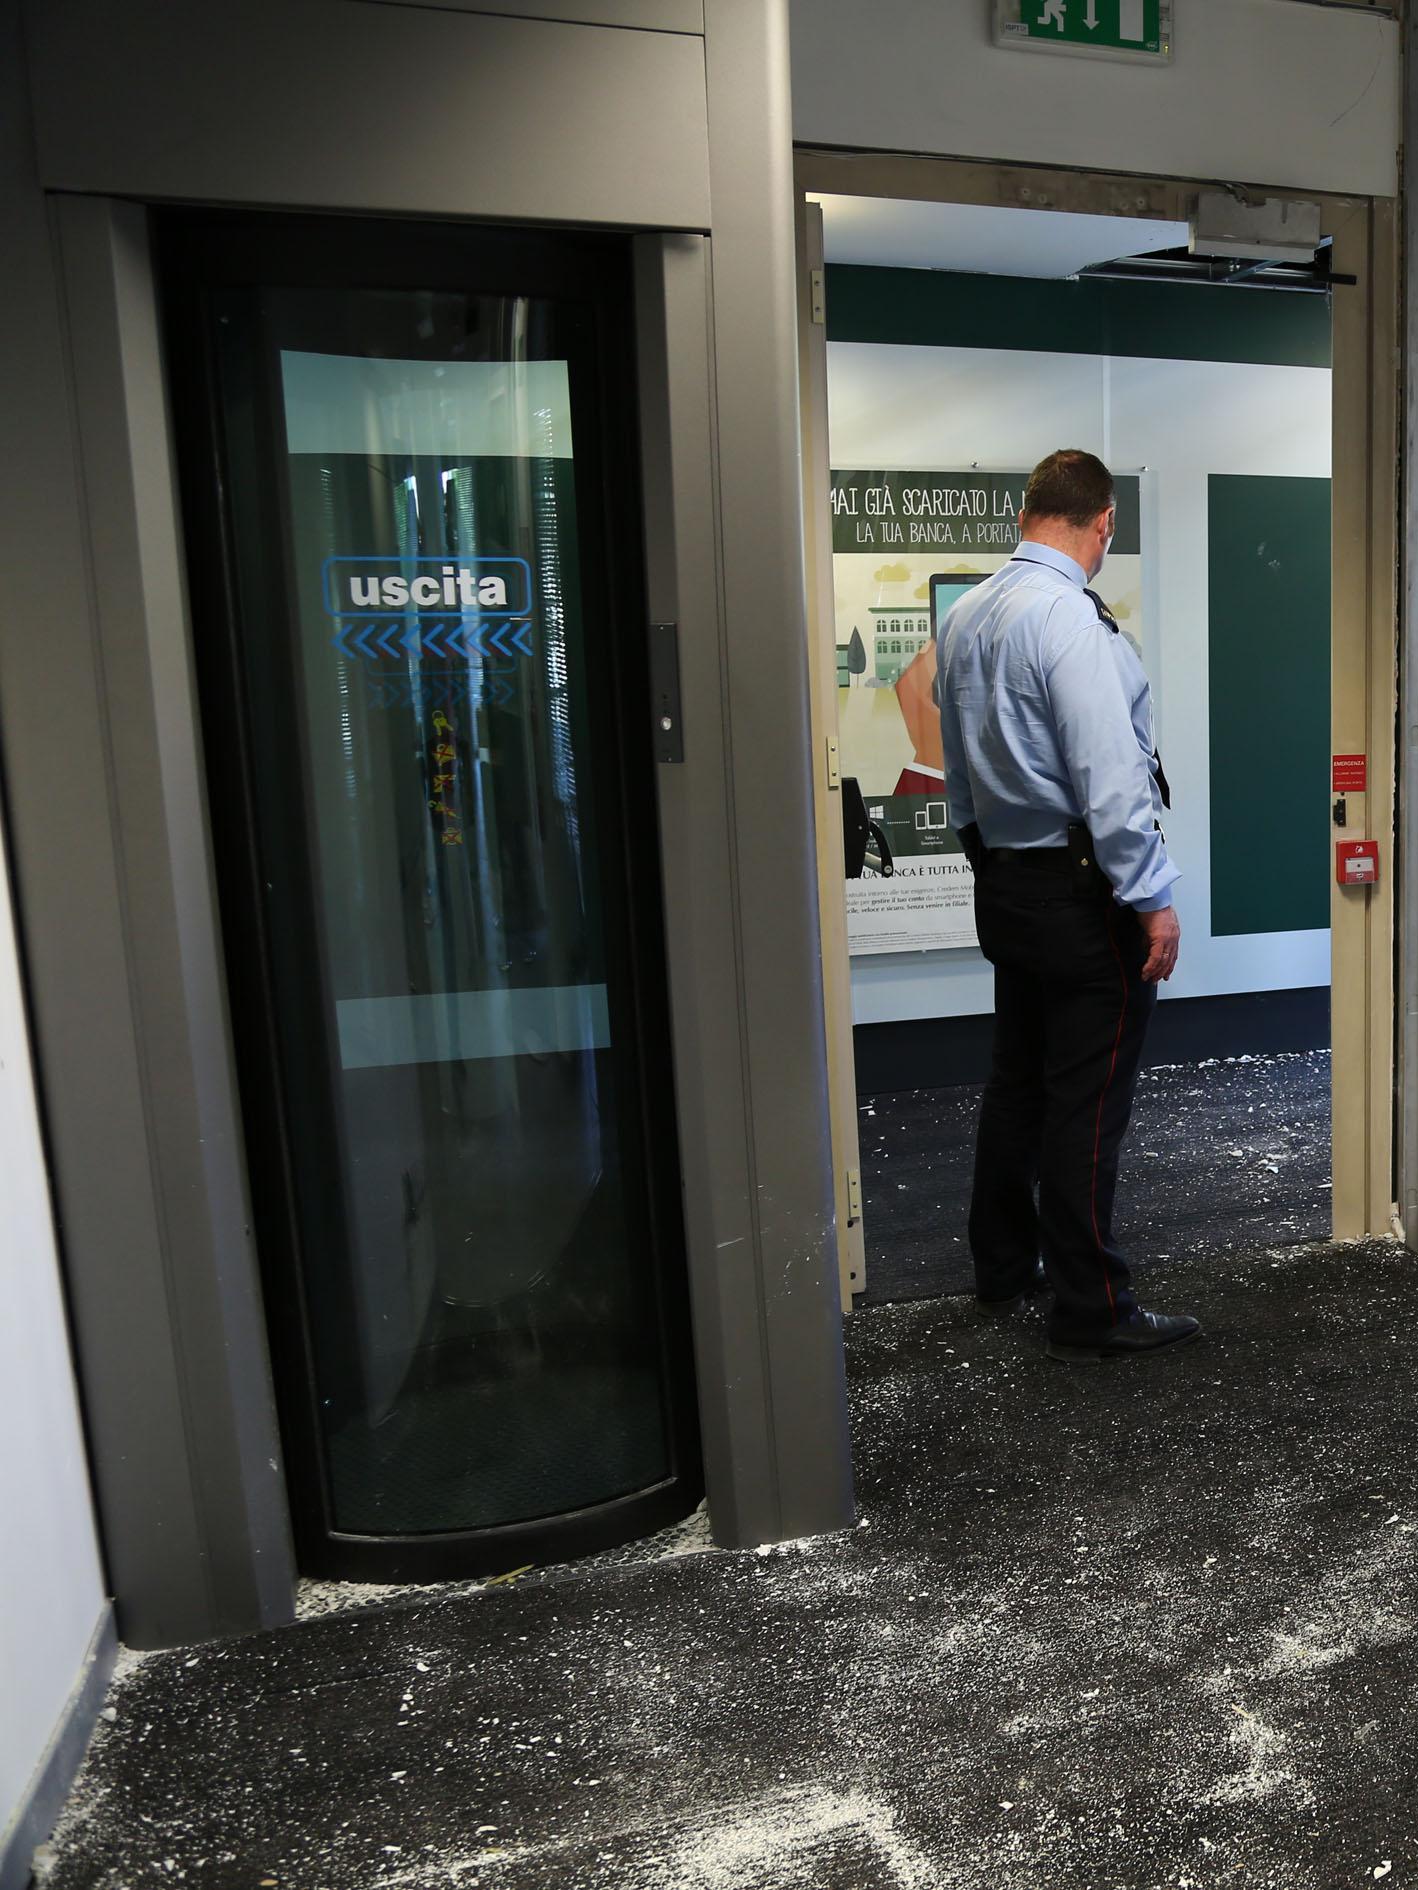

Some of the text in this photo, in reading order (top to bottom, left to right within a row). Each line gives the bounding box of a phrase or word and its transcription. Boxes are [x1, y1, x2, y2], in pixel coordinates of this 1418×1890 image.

[865, 484, 896, 515] GIÀ
[902, 488, 987, 516] SCARICATO
[993, 489, 1015, 517] LA
[856, 521, 875, 542] LA
[879, 521, 904, 543] TUA
[909, 522, 956, 545] BANCA,
[961, 523, 972, 543] A
[350, 566, 508, 606] uscita
[919, 865, 926, 877] È
[927, 865, 959, 876] TUTTA
